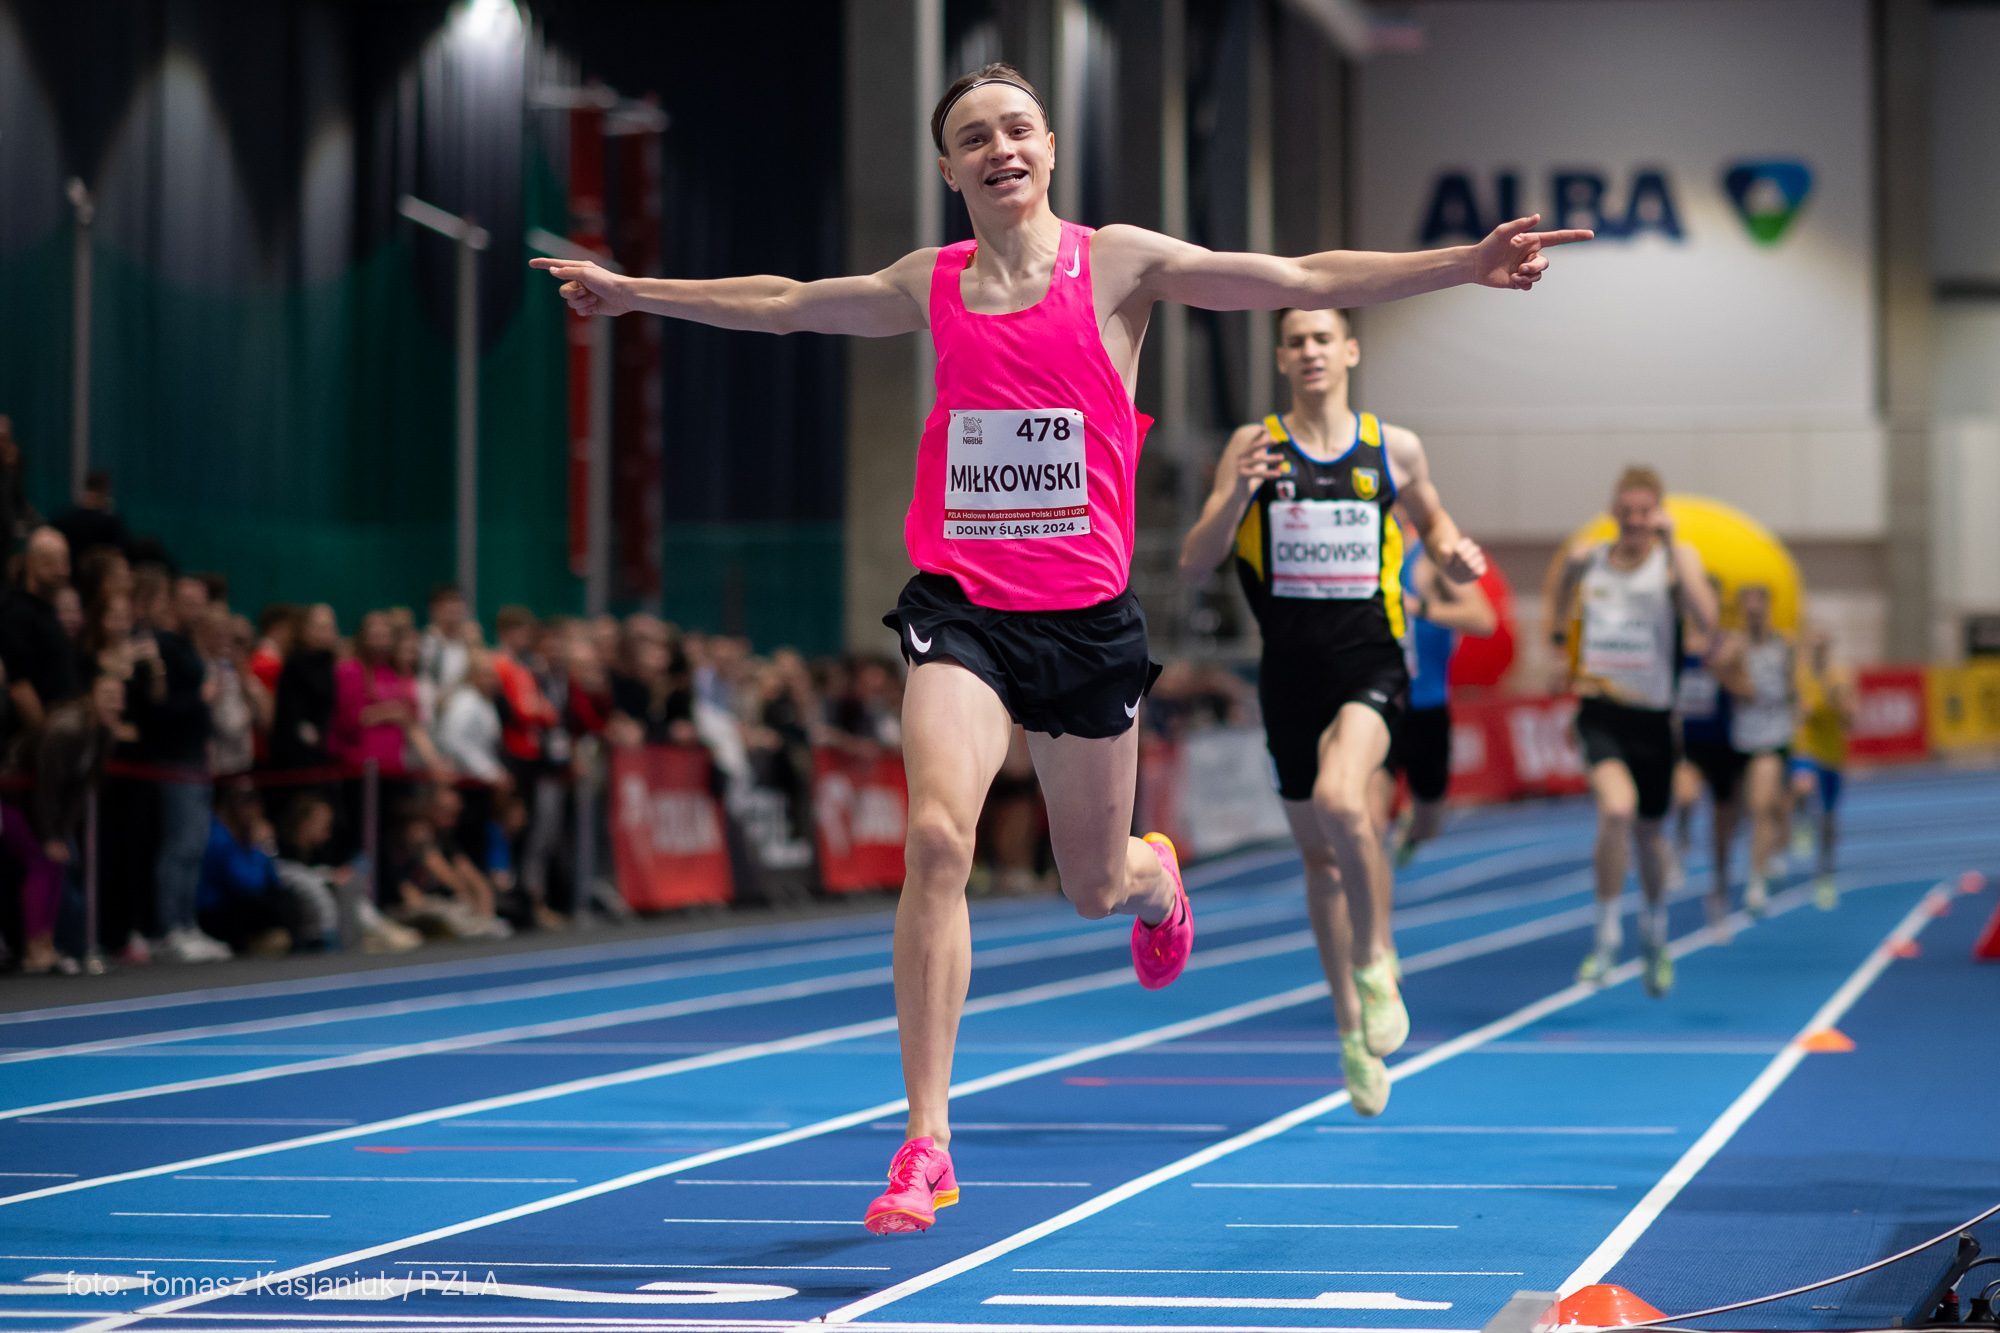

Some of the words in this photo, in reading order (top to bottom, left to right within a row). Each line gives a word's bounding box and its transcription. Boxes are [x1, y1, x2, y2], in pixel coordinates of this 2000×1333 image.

[1016, 417, 1071, 442] 478
[950, 462, 1081, 493] MIŁKOWSKI
[947, 511, 961, 519] PZLA
[987, 510, 1030, 520] Mistrzostwa
[1031, 510, 1052, 518] Polski
[1053, 509, 1066, 517] U18
[1071, 507, 1085, 516] U20
[1333, 508, 1370, 526] 136
[956, 525, 996, 536] DOLNY
[999, 522, 1040, 537] ŚLĄSK
[1042, 522, 1075, 534] 2024
